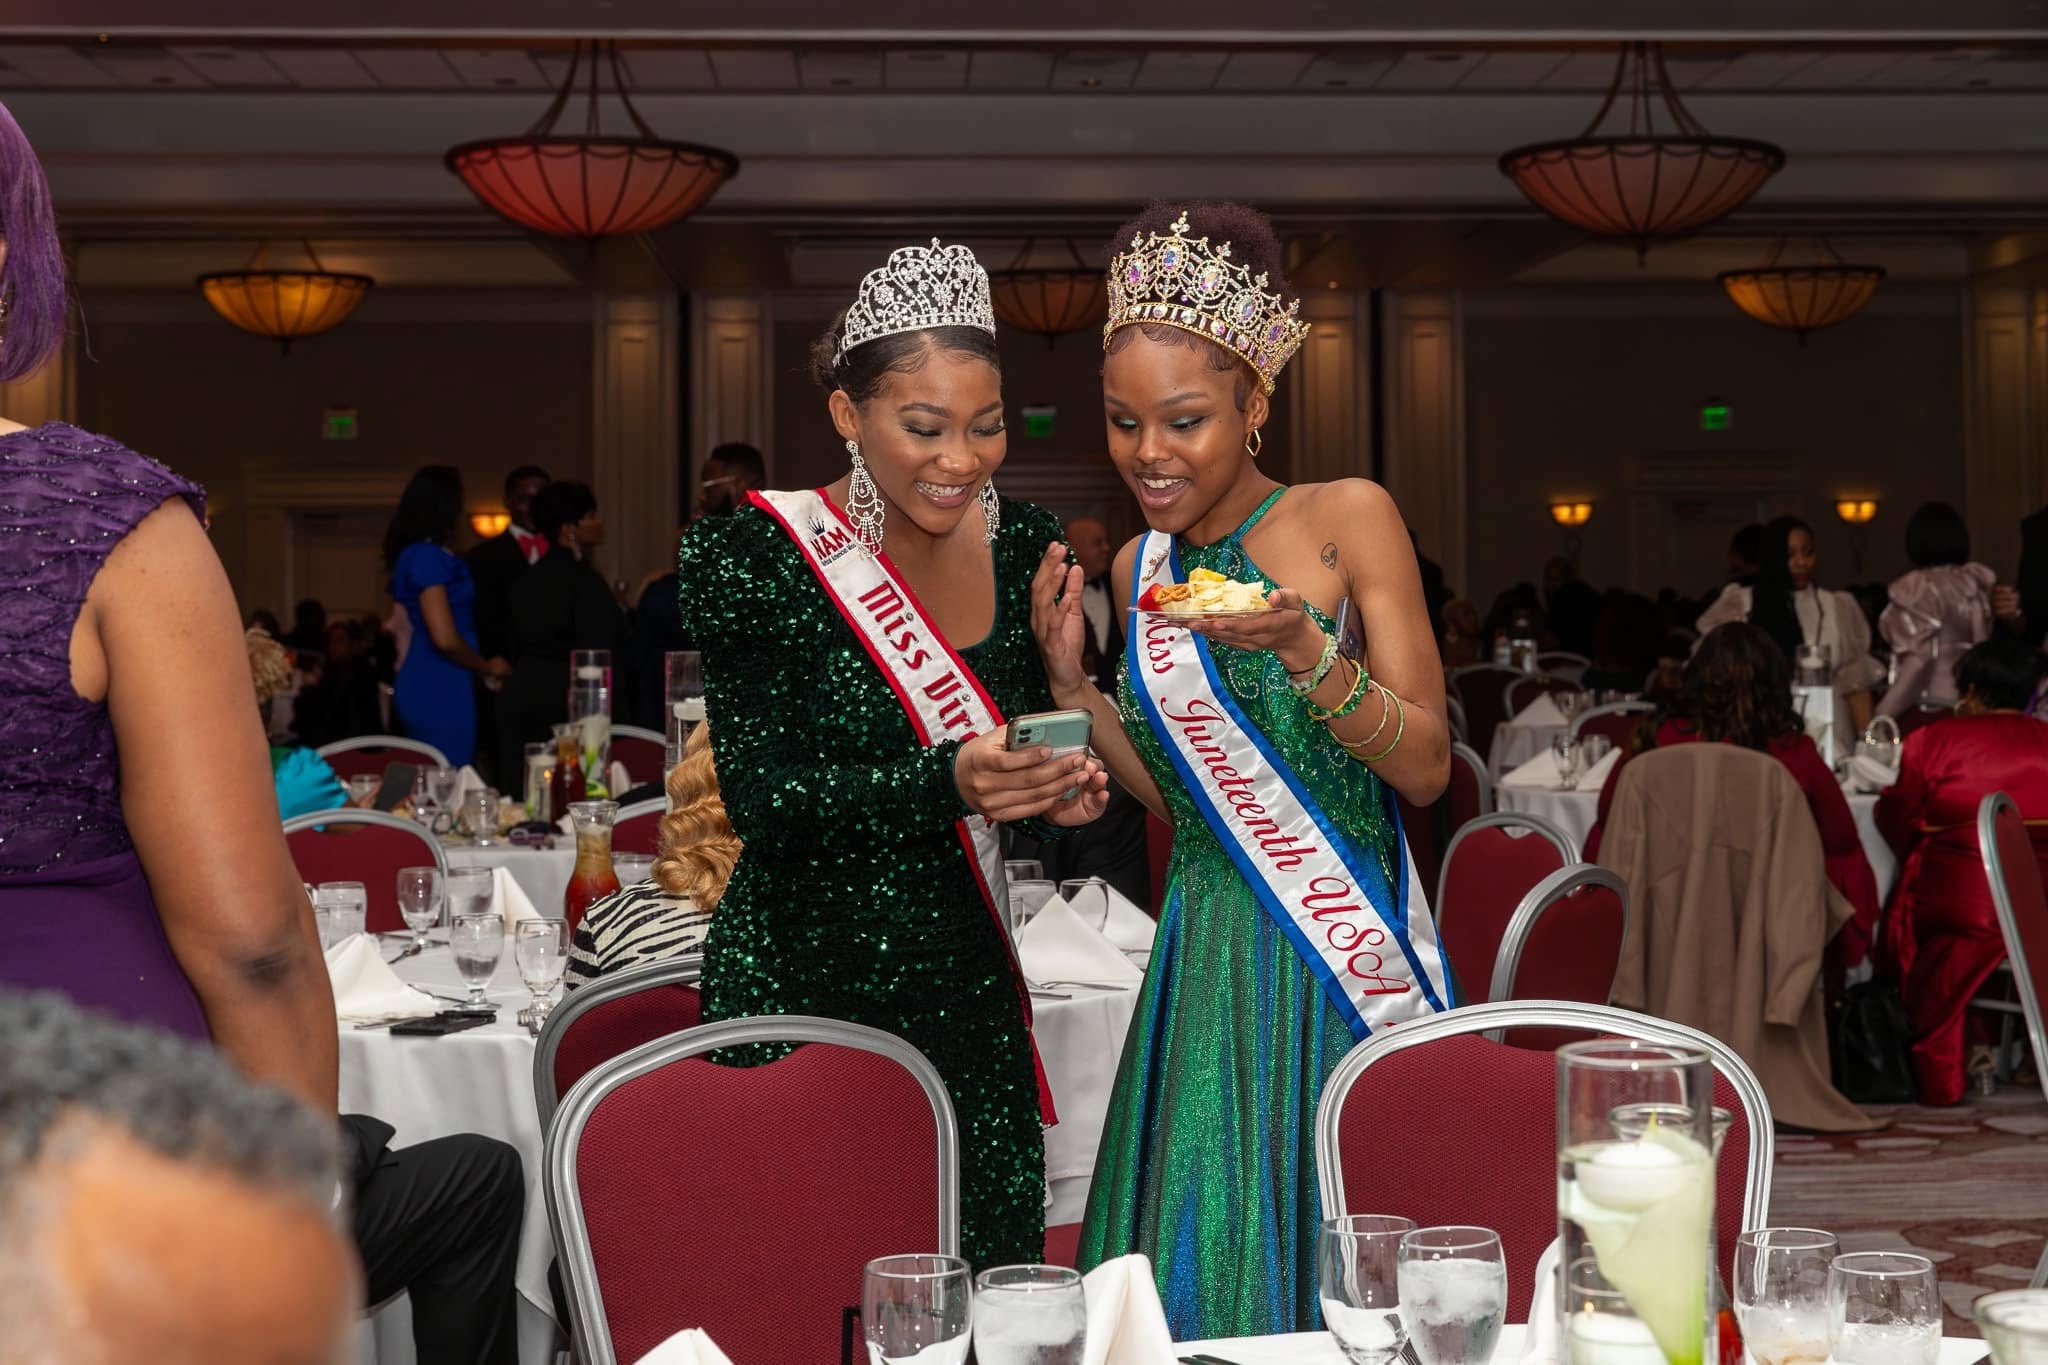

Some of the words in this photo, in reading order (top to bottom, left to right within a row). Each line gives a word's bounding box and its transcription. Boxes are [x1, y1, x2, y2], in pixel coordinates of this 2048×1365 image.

[810, 526, 852, 560] NAM
[858, 580, 933, 670] Miss
[1160, 697, 1317, 872] Juneteenth
[1302, 877, 1411, 996] USA
